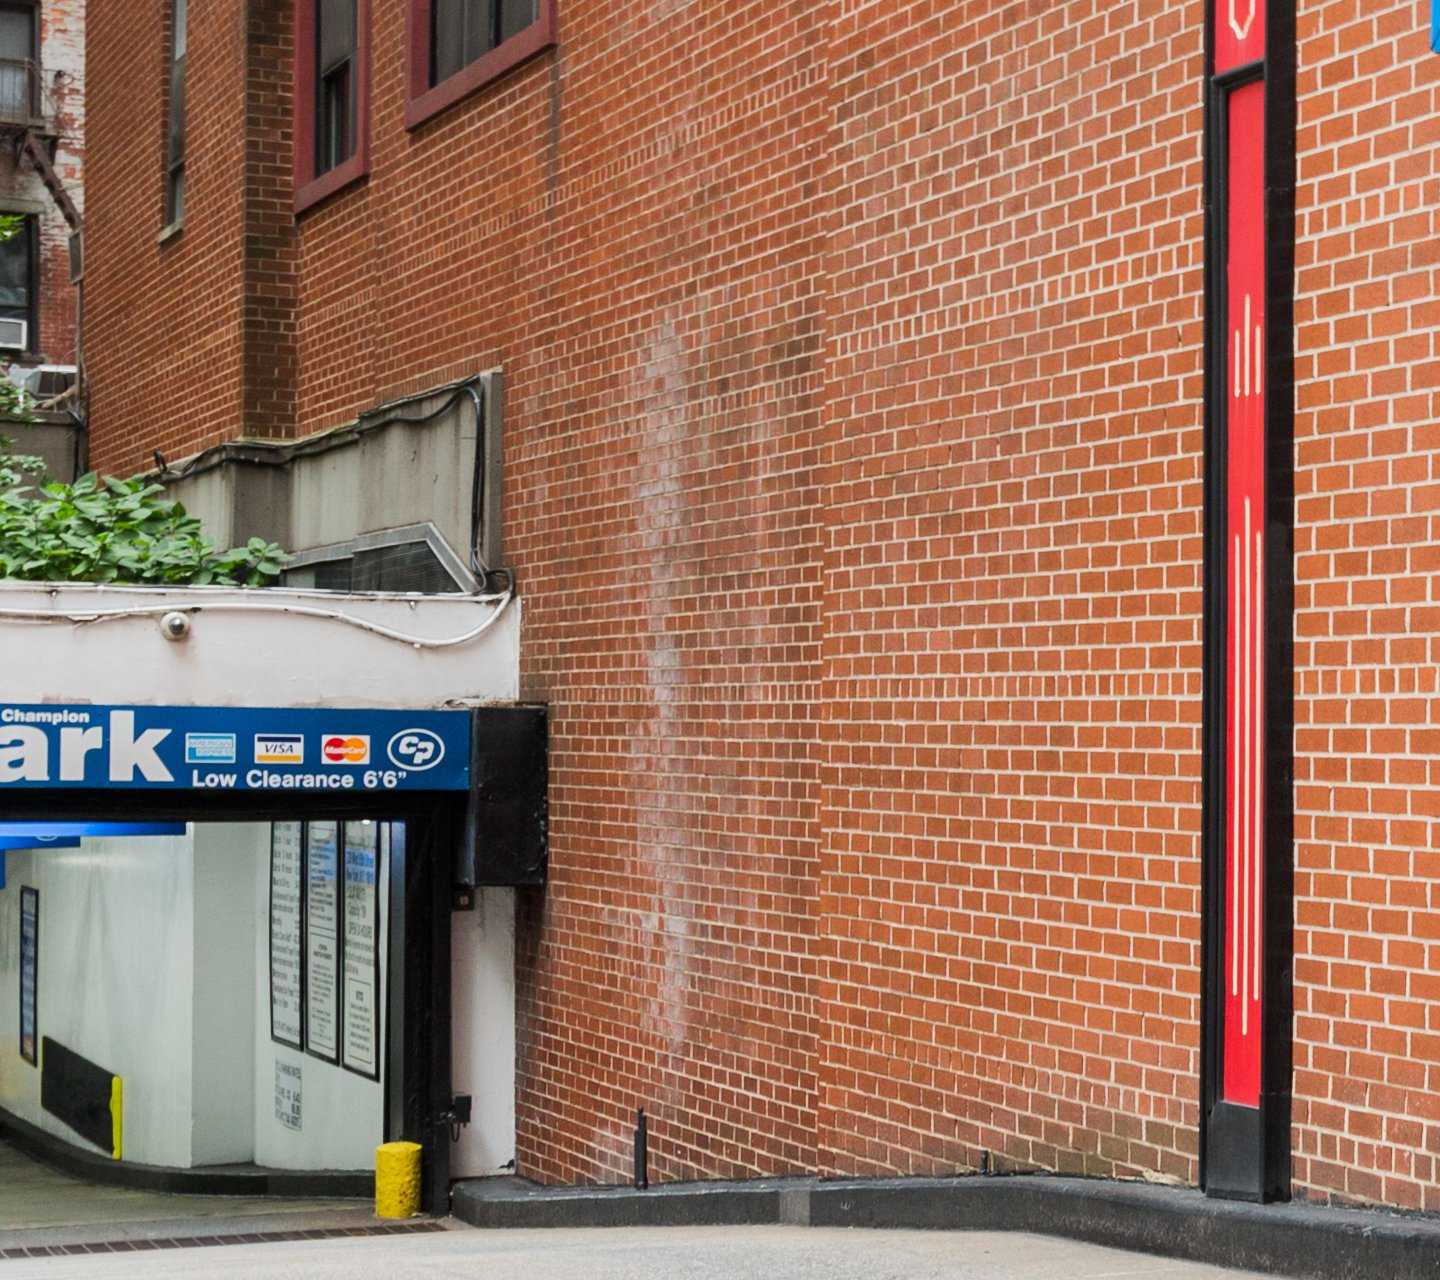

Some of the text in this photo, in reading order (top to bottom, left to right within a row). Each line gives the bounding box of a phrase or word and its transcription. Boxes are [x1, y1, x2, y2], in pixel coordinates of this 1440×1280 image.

[1, 708, 90, 726] Champion
[264, 743, 294, 754] VISA
[192, 770, 237, 788] Low
[246, 769, 354, 788] Clearance
